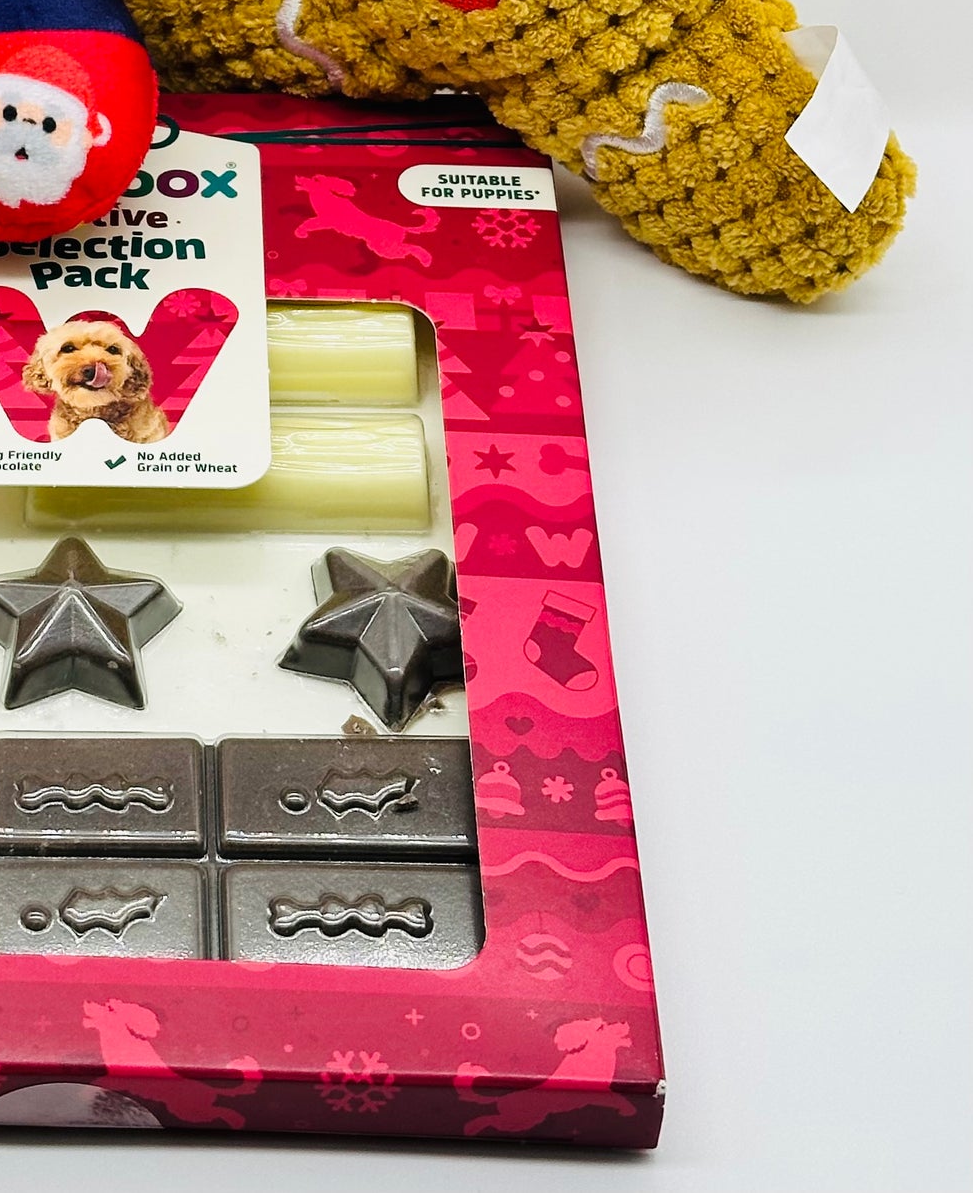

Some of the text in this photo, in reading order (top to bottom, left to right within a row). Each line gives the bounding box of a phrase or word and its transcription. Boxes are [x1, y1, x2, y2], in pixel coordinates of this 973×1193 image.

[438, 174, 521, 186] SUITABLE
[421, 187, 454, 198] FOR
[29, 261, 150, 290] Pack
[8, 450, 62, 462] Friendly
[137, 451, 201, 461] No Added
[137, 462, 238, 473] Grain or Wheat
